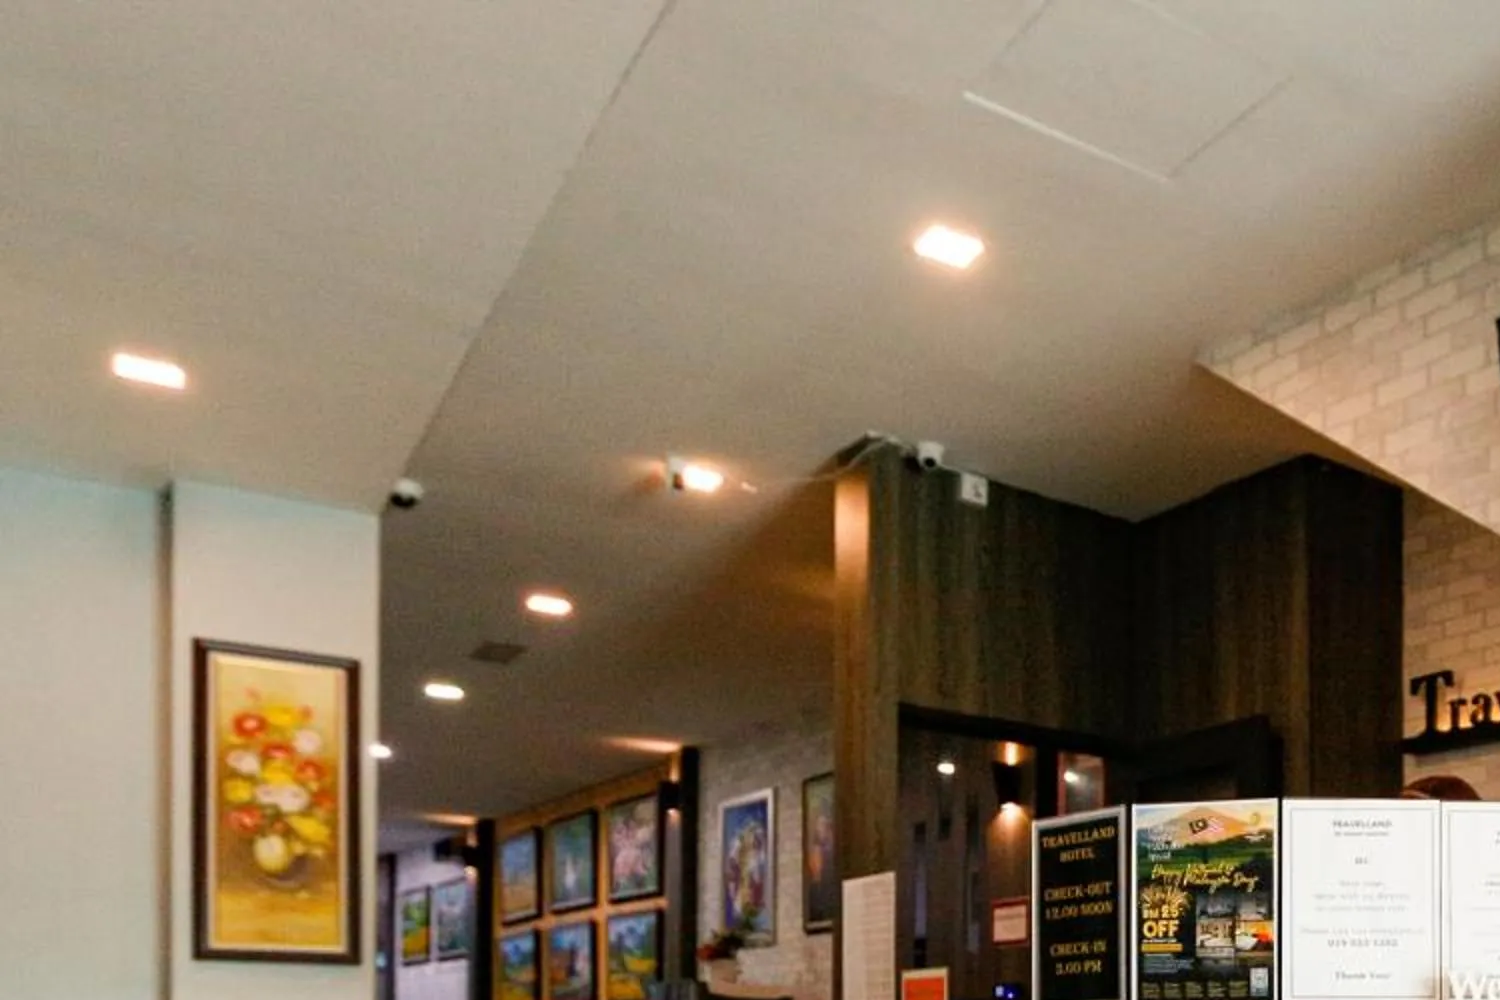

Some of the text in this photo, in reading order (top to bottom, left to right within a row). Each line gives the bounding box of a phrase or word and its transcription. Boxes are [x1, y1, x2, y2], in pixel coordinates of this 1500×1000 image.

[1042, 825, 1116, 848] TRAVELLAND
[1059, 847, 1096, 863] HOTEL
[1044, 881, 1112, 901] CHECK-OUT
[1142, 920, 1180, 938] OFF
[1050, 939, 1107, 958] CHECK-IN
